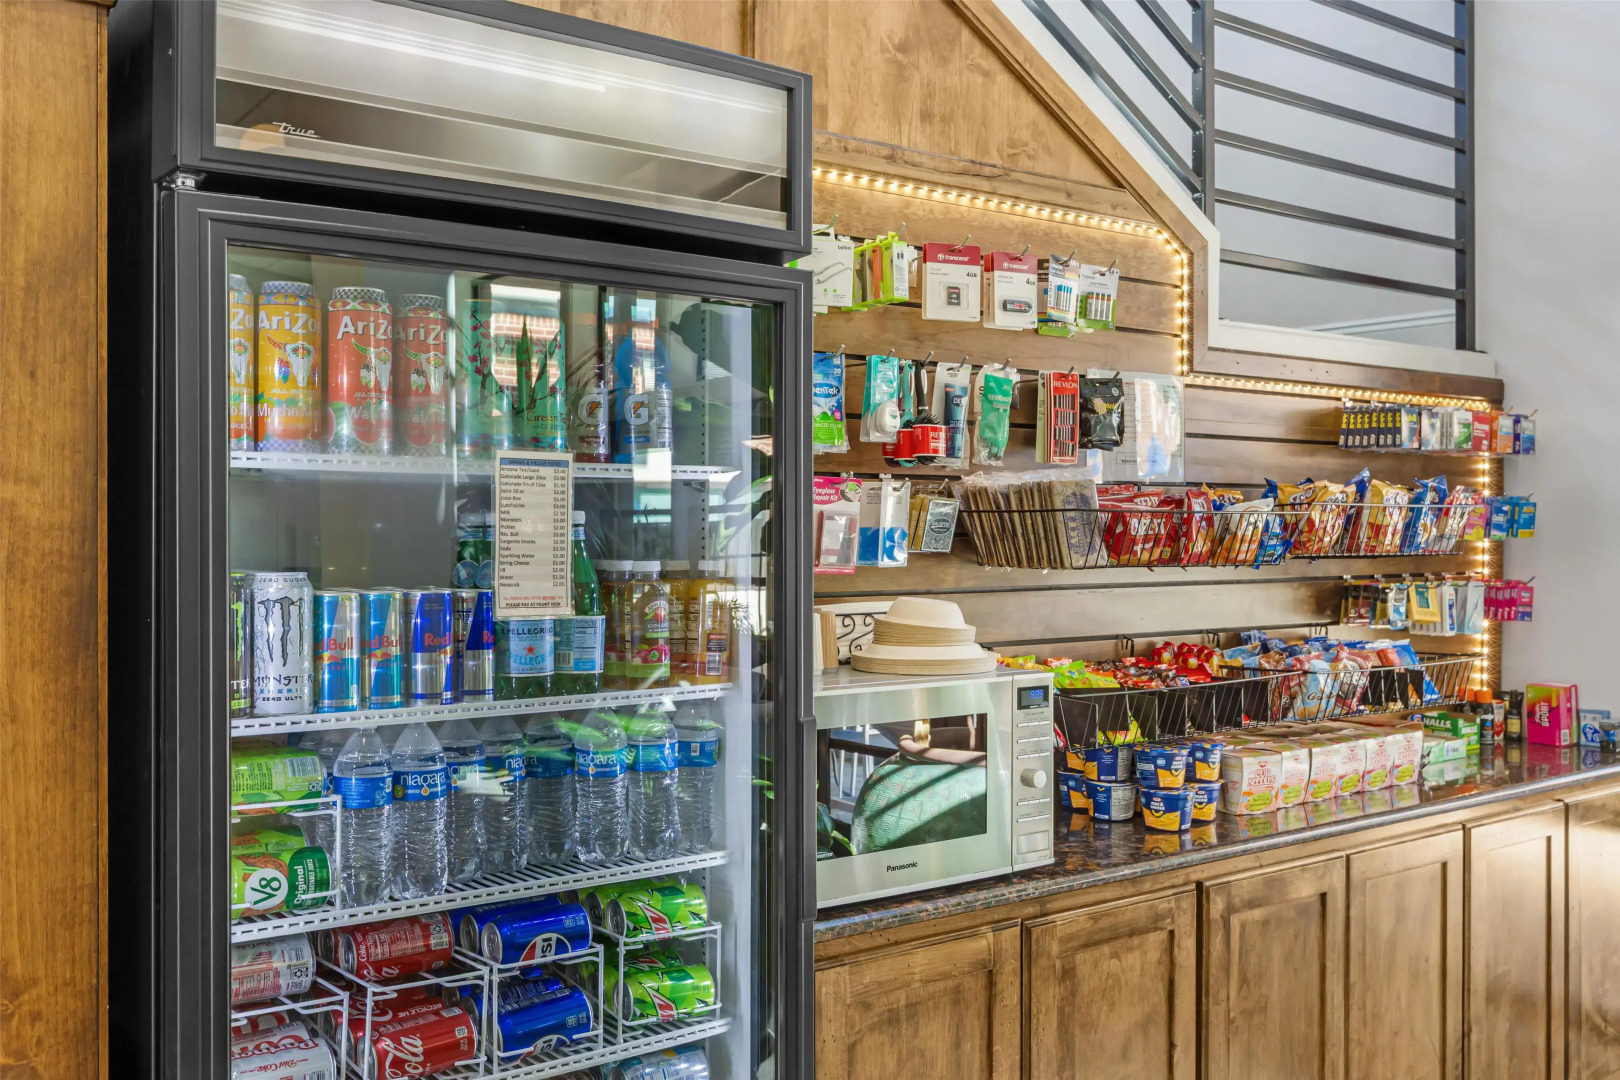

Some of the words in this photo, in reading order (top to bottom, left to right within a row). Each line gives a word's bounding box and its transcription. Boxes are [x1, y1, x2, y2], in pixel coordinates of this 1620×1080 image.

[272, 121, 320, 138] true
[945, 254, 970, 262] Transcend
[258, 310, 321, 334] AriZo
[1054, 380, 1078, 388] REVLON
[624, 394, 648, 426] G
[526, 411, 557, 422] Green
[482, 631, 496, 644] Re
[328, 637, 354, 652] Bull
[1541, 702, 1550, 727] SPORT
[1424, 718, 1452, 729] HALLS
[1462, 726, 1477, 734] HALLS
[576, 752, 616, 766] niagara
[1254, 768, 1271, 778] CUP
[400, 772, 446, 790] niagara
[886, 861, 918, 872] Panasonic
[294, 865, 304, 904] Original
[250, 876, 282, 906] V8
[410, 1003, 442, 1015] RECYCLE
[255, 1063, 278, 1072] Coke
[278, 1059, 297, 1068] Diet
